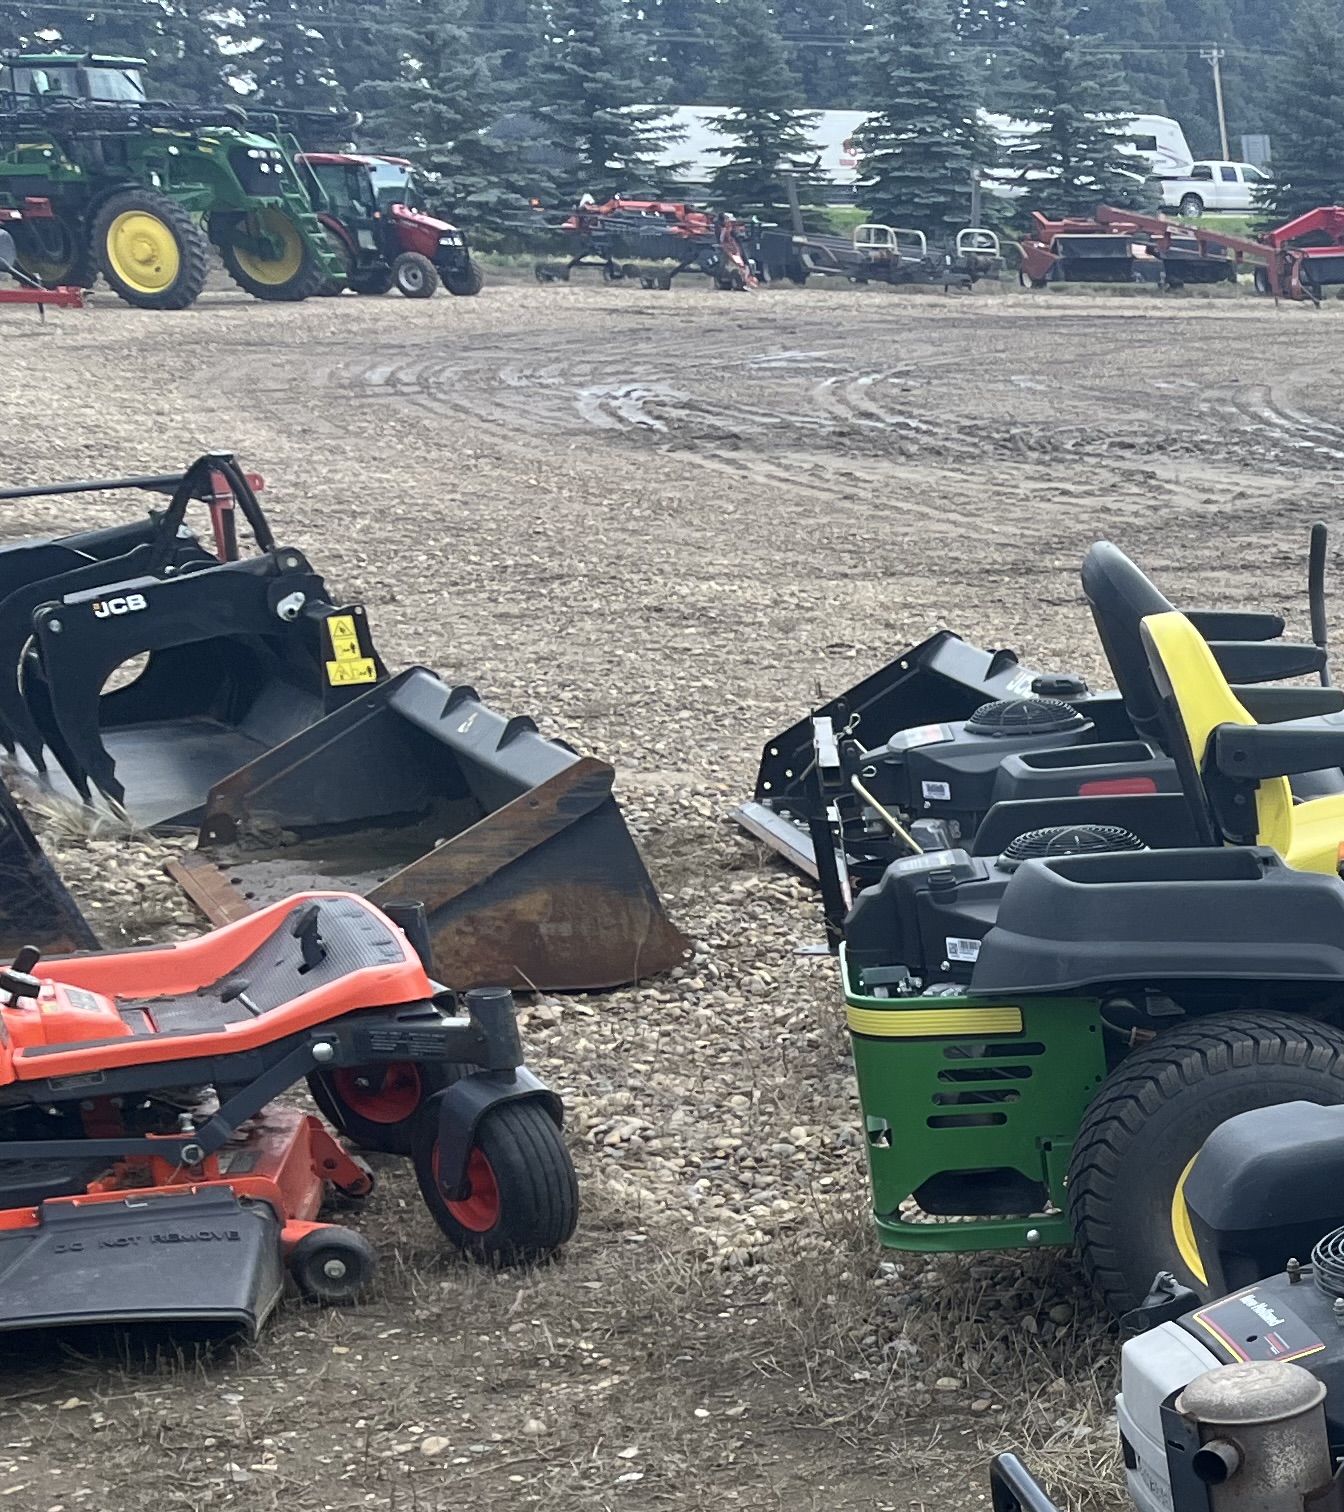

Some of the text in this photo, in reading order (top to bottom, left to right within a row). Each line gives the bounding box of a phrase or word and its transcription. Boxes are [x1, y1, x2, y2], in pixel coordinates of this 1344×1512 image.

[91, 593, 148, 618] JCB
[151, 1230, 242, 1244] REMOVE
[1239, 1293, 1286, 1327] New Holland
